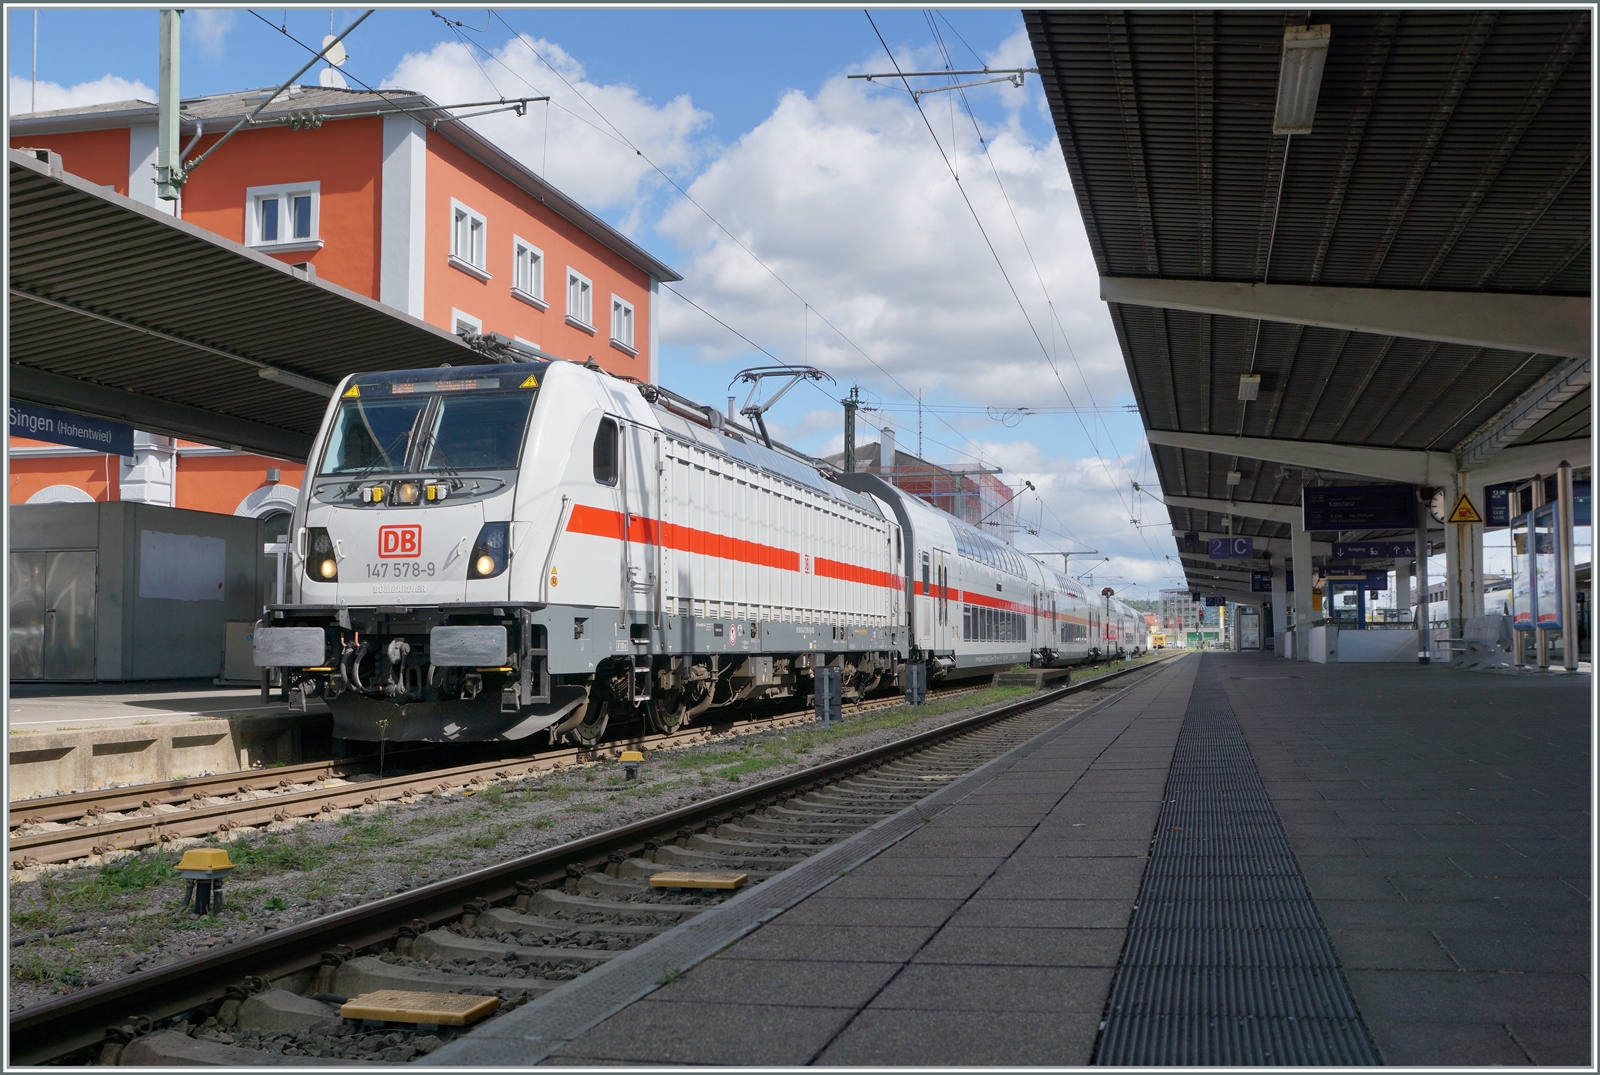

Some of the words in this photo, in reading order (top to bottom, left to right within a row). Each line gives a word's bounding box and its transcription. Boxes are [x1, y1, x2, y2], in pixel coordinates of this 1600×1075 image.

[9, 407, 53, 433] Singen
[57, 420, 112, 444] (Hohentwiel)
[383, 529, 417, 553] DB
[1212, 539, 1222, 555] 2
[1234, 538, 1247, 555] C
[365, 563, 389, 578] 147
[393, 562, 435, 578] 578-9
[372, 584, 427, 594] BOMBARDIER
